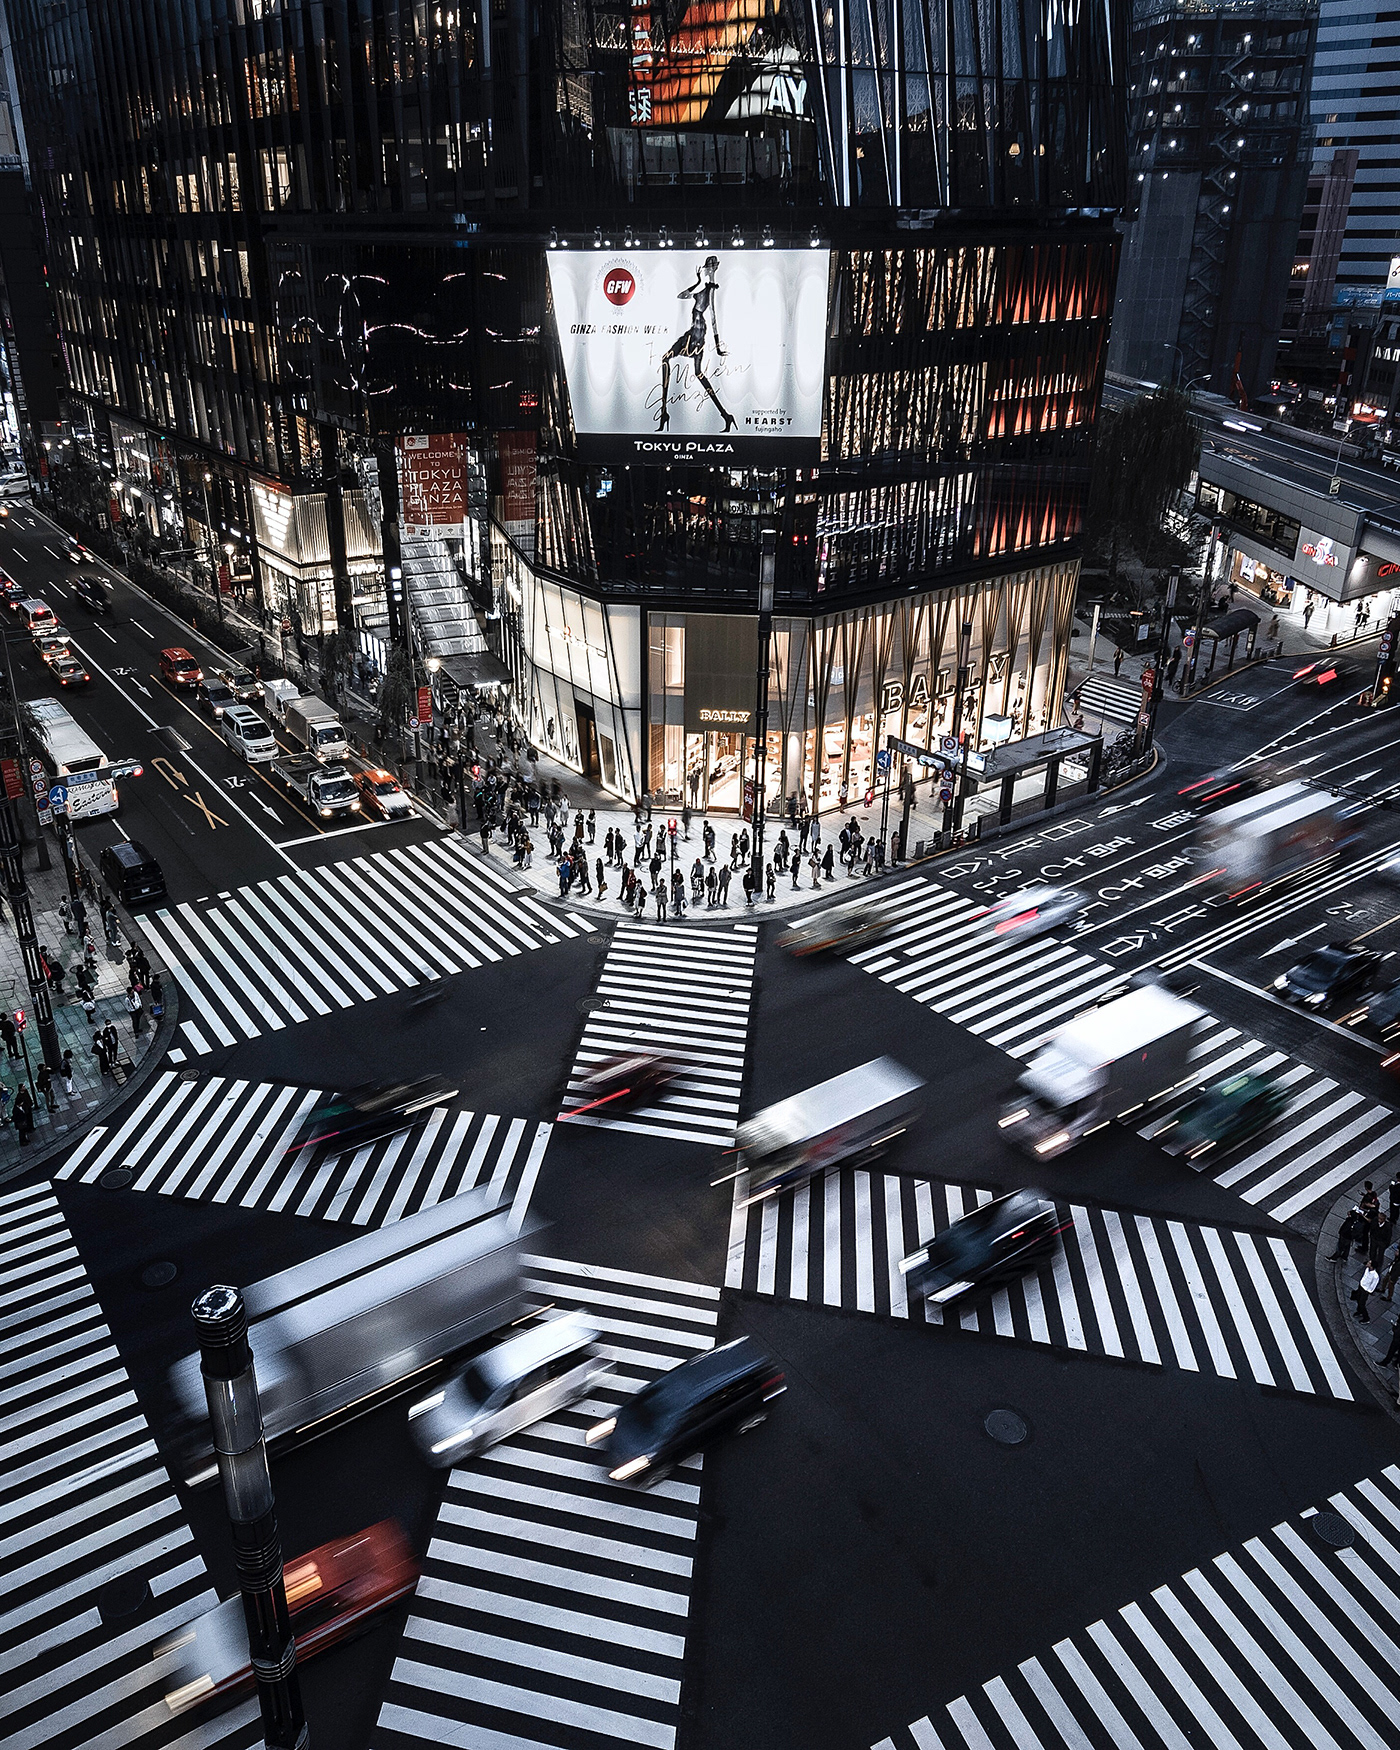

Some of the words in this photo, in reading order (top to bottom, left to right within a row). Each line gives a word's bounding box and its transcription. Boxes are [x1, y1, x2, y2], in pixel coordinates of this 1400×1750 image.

[607, 280, 632, 295] GFW
[569, 324, 597, 334] GINZA
[601, 324, 639, 334] FASHION
[657, 363, 751, 389] Modern
[745, 417, 793, 425] HEARST
[634, 441, 681, 453] TOKYU
[685, 441, 734, 453] PLAZA
[409, 451, 455, 460] WELCOME
[409, 468, 462, 480] TOKYU
[409, 481, 463, 493] PLAZA
[882, 651, 1012, 714] BALLY
[700, 709, 751, 723] BALLY
